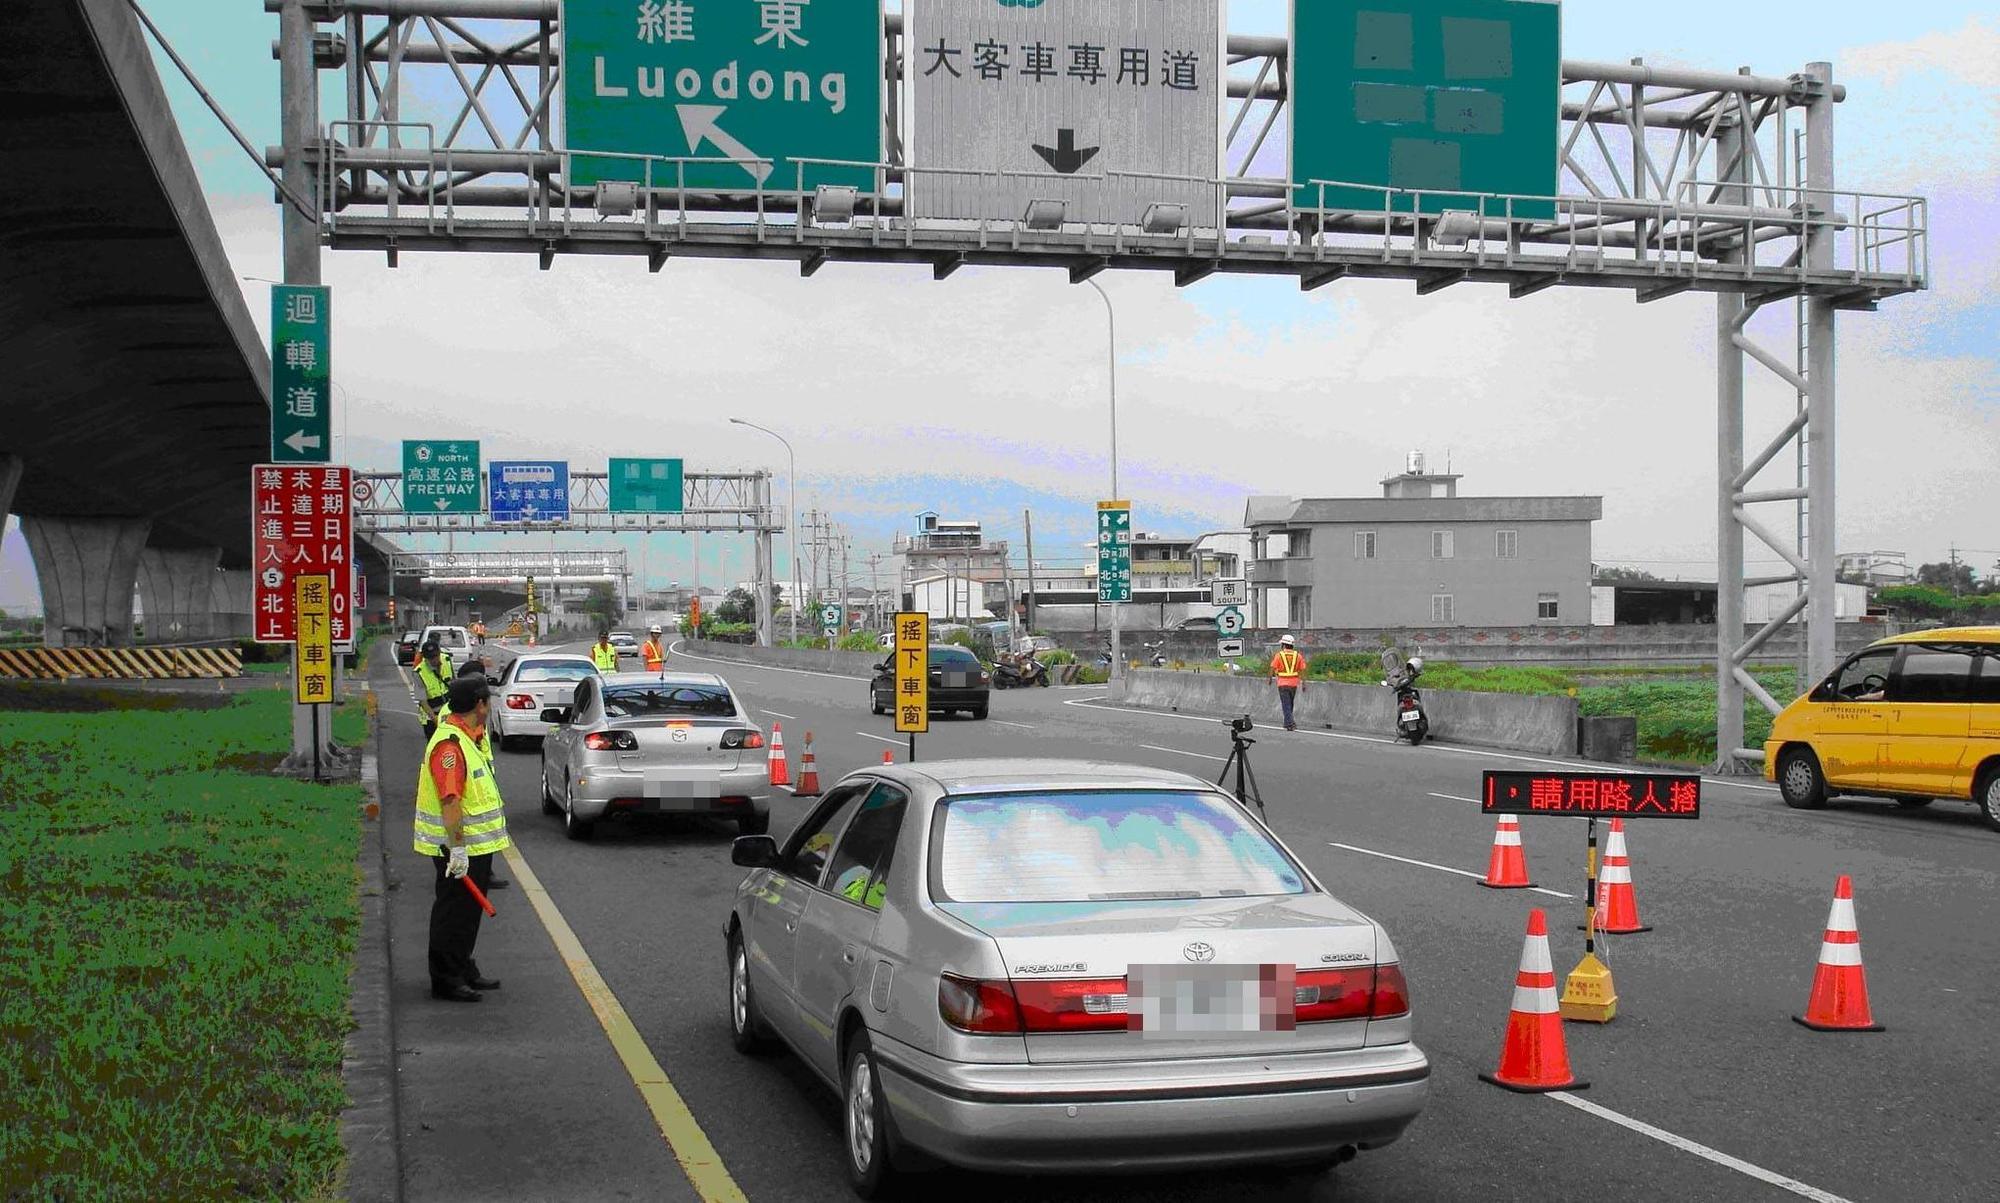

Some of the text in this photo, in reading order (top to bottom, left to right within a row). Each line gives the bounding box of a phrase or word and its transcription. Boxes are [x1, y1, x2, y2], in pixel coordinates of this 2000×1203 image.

[924, 38, 1199, 90] 大客車專用道
[595, 56, 846, 114] Luodong
[286, 294, 317, 418] 迴轉道
[408, 466, 475, 481] 高速公路
[355, 487, 367, 496] 40
[408, 484, 475, 495] FREEWAY
[495, 488, 565, 500] 大客車專用
[1100, 590, 1112, 599] 37
[1223, 583, 1235, 595] 南
[1226, 616, 1235, 628] 5
[303, 583, 326, 696] 搖下車窗
[901, 620, 921, 725] 搖下車窗
